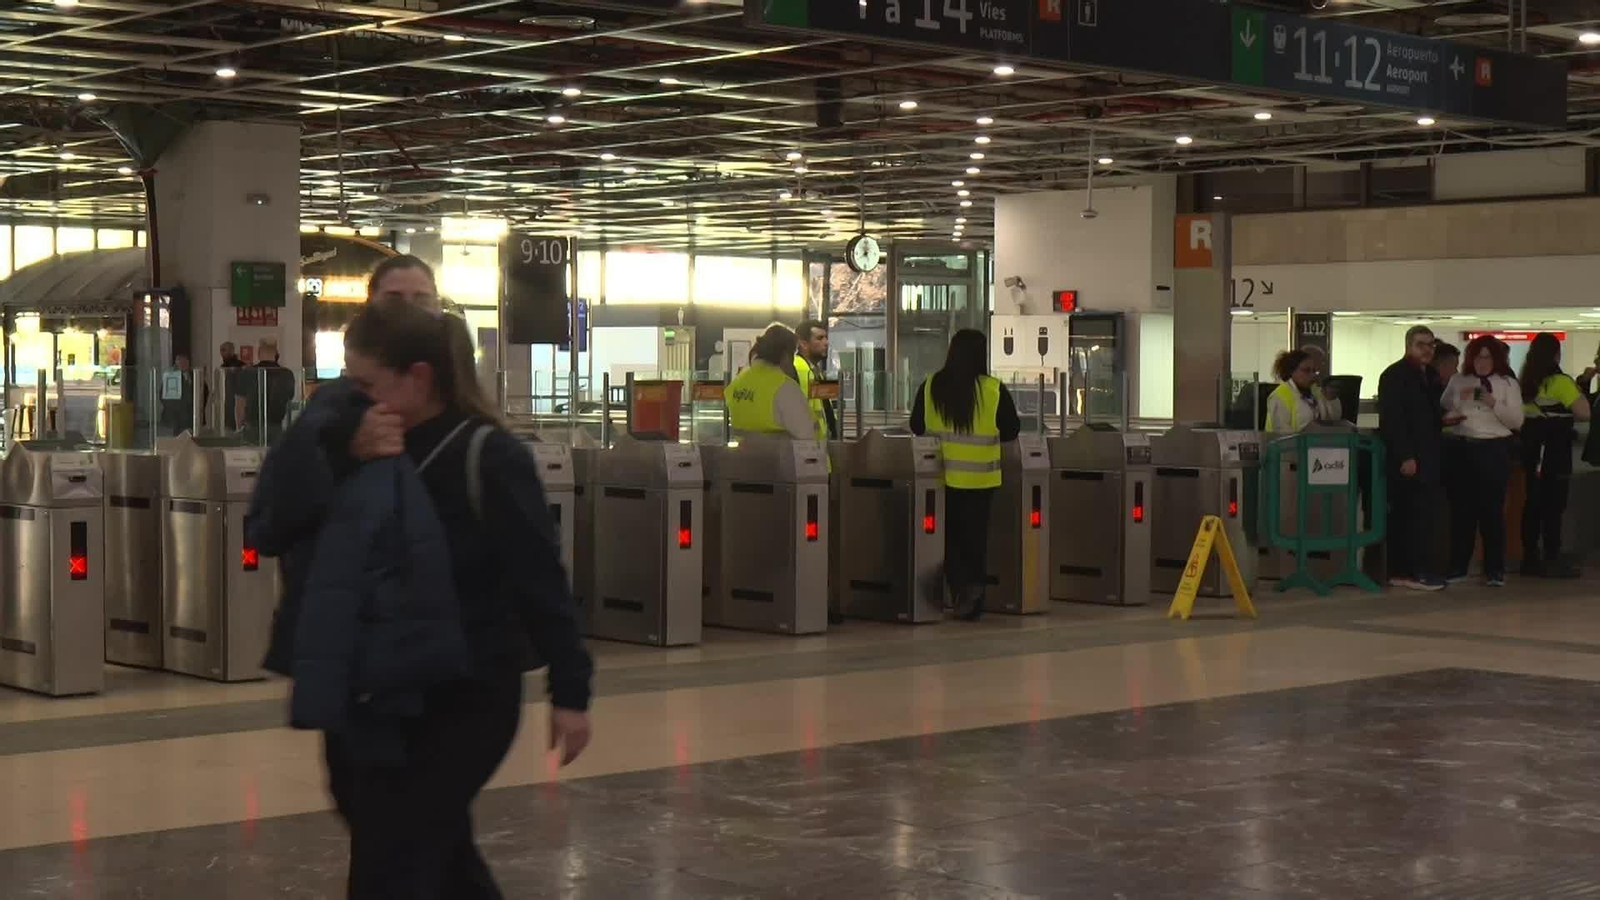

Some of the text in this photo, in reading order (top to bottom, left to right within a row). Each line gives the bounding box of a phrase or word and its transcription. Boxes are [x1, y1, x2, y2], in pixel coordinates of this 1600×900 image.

[980, 1, 1007, 21] Vies
[1386, 41, 1439, 63] Aeropuerto
[1386, 63, 1428, 84] Aeroport
[1190, 219, 1212, 250] R
